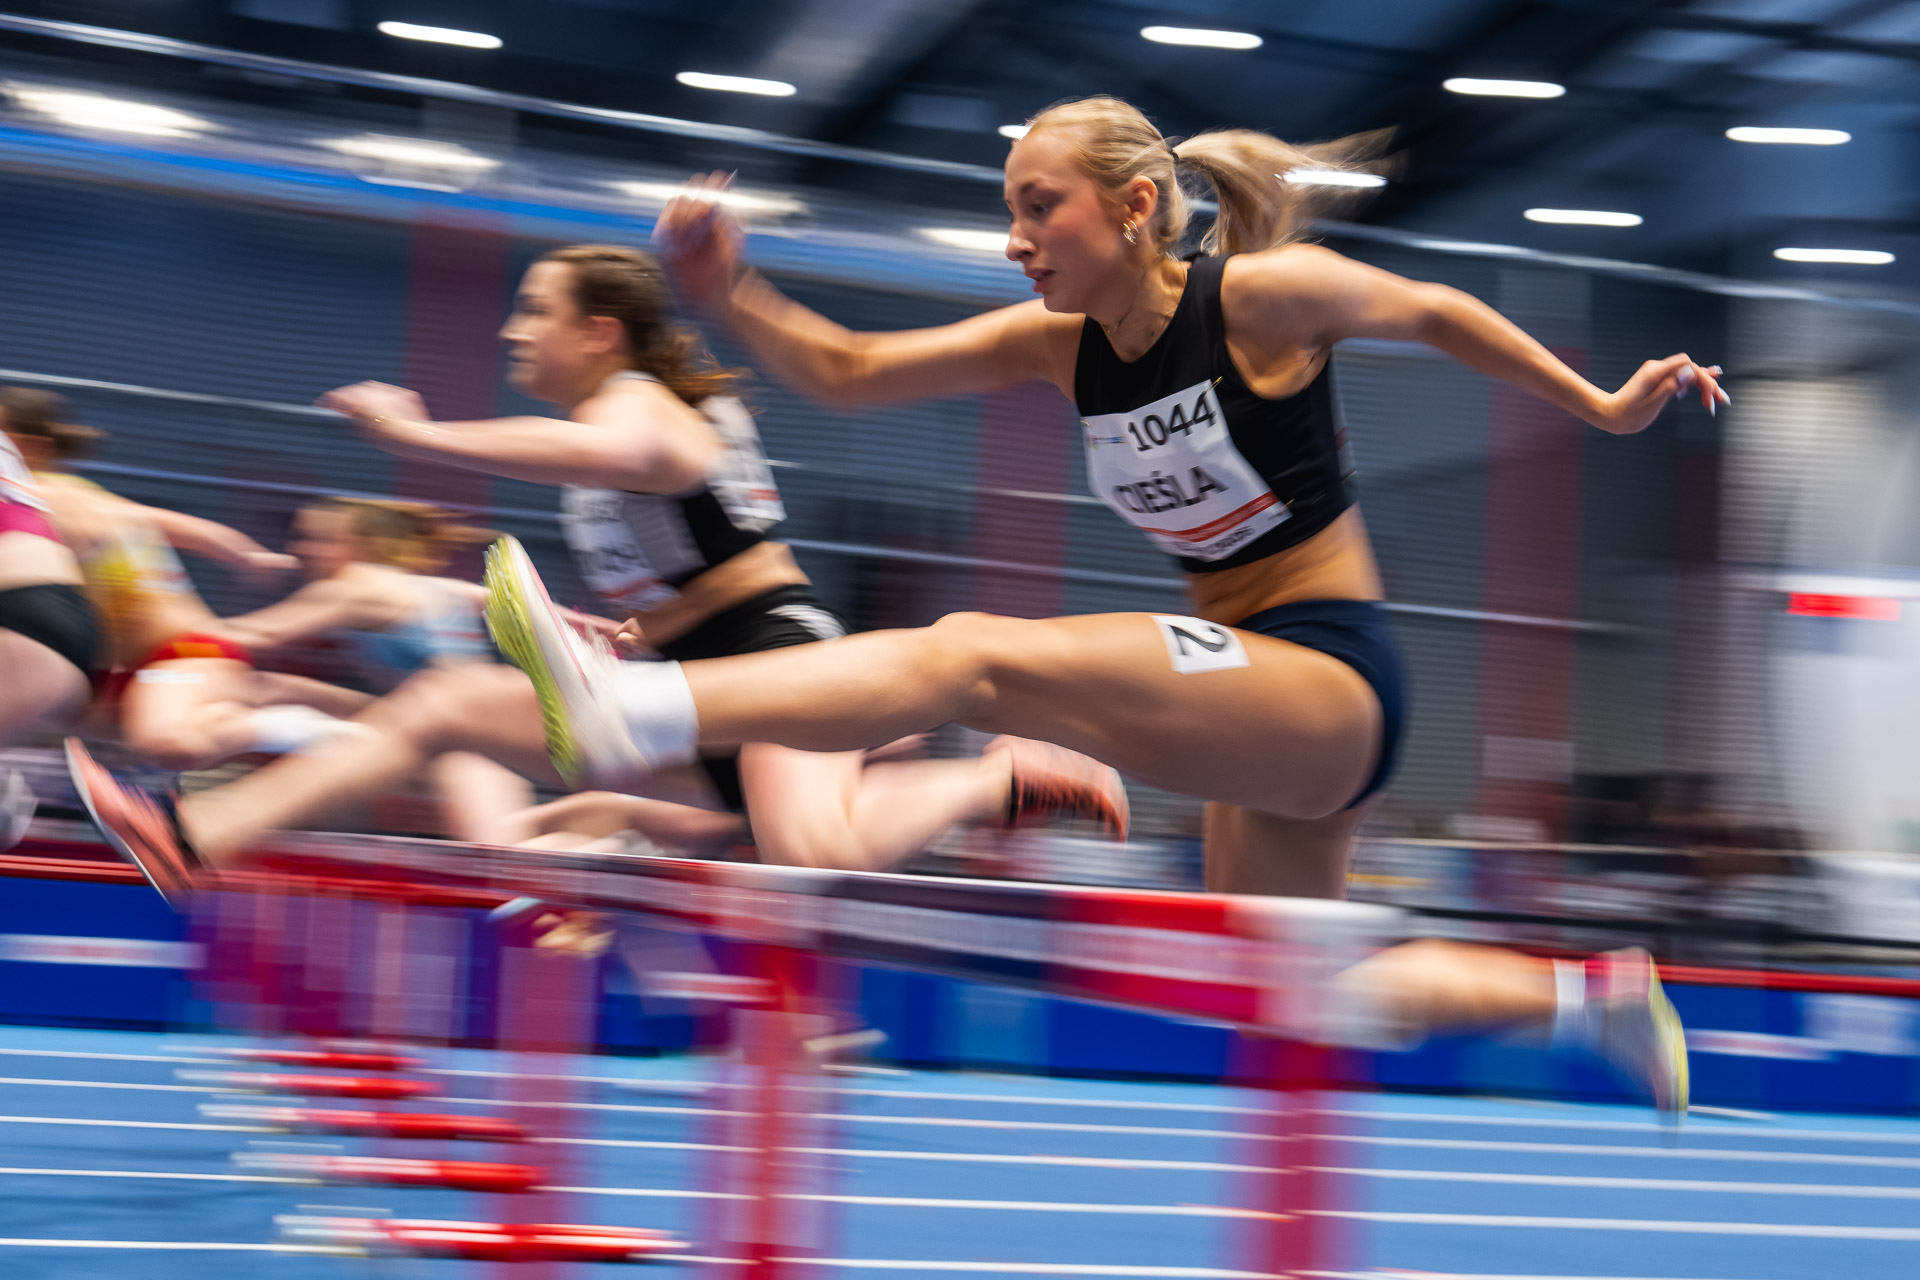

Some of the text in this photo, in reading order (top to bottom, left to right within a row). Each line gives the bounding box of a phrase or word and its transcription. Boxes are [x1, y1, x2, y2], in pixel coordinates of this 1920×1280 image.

[1127, 391, 1216, 452] 1044
[1112, 466, 1229, 514] CIEŚLA
[1167, 624, 1228, 656] 2
